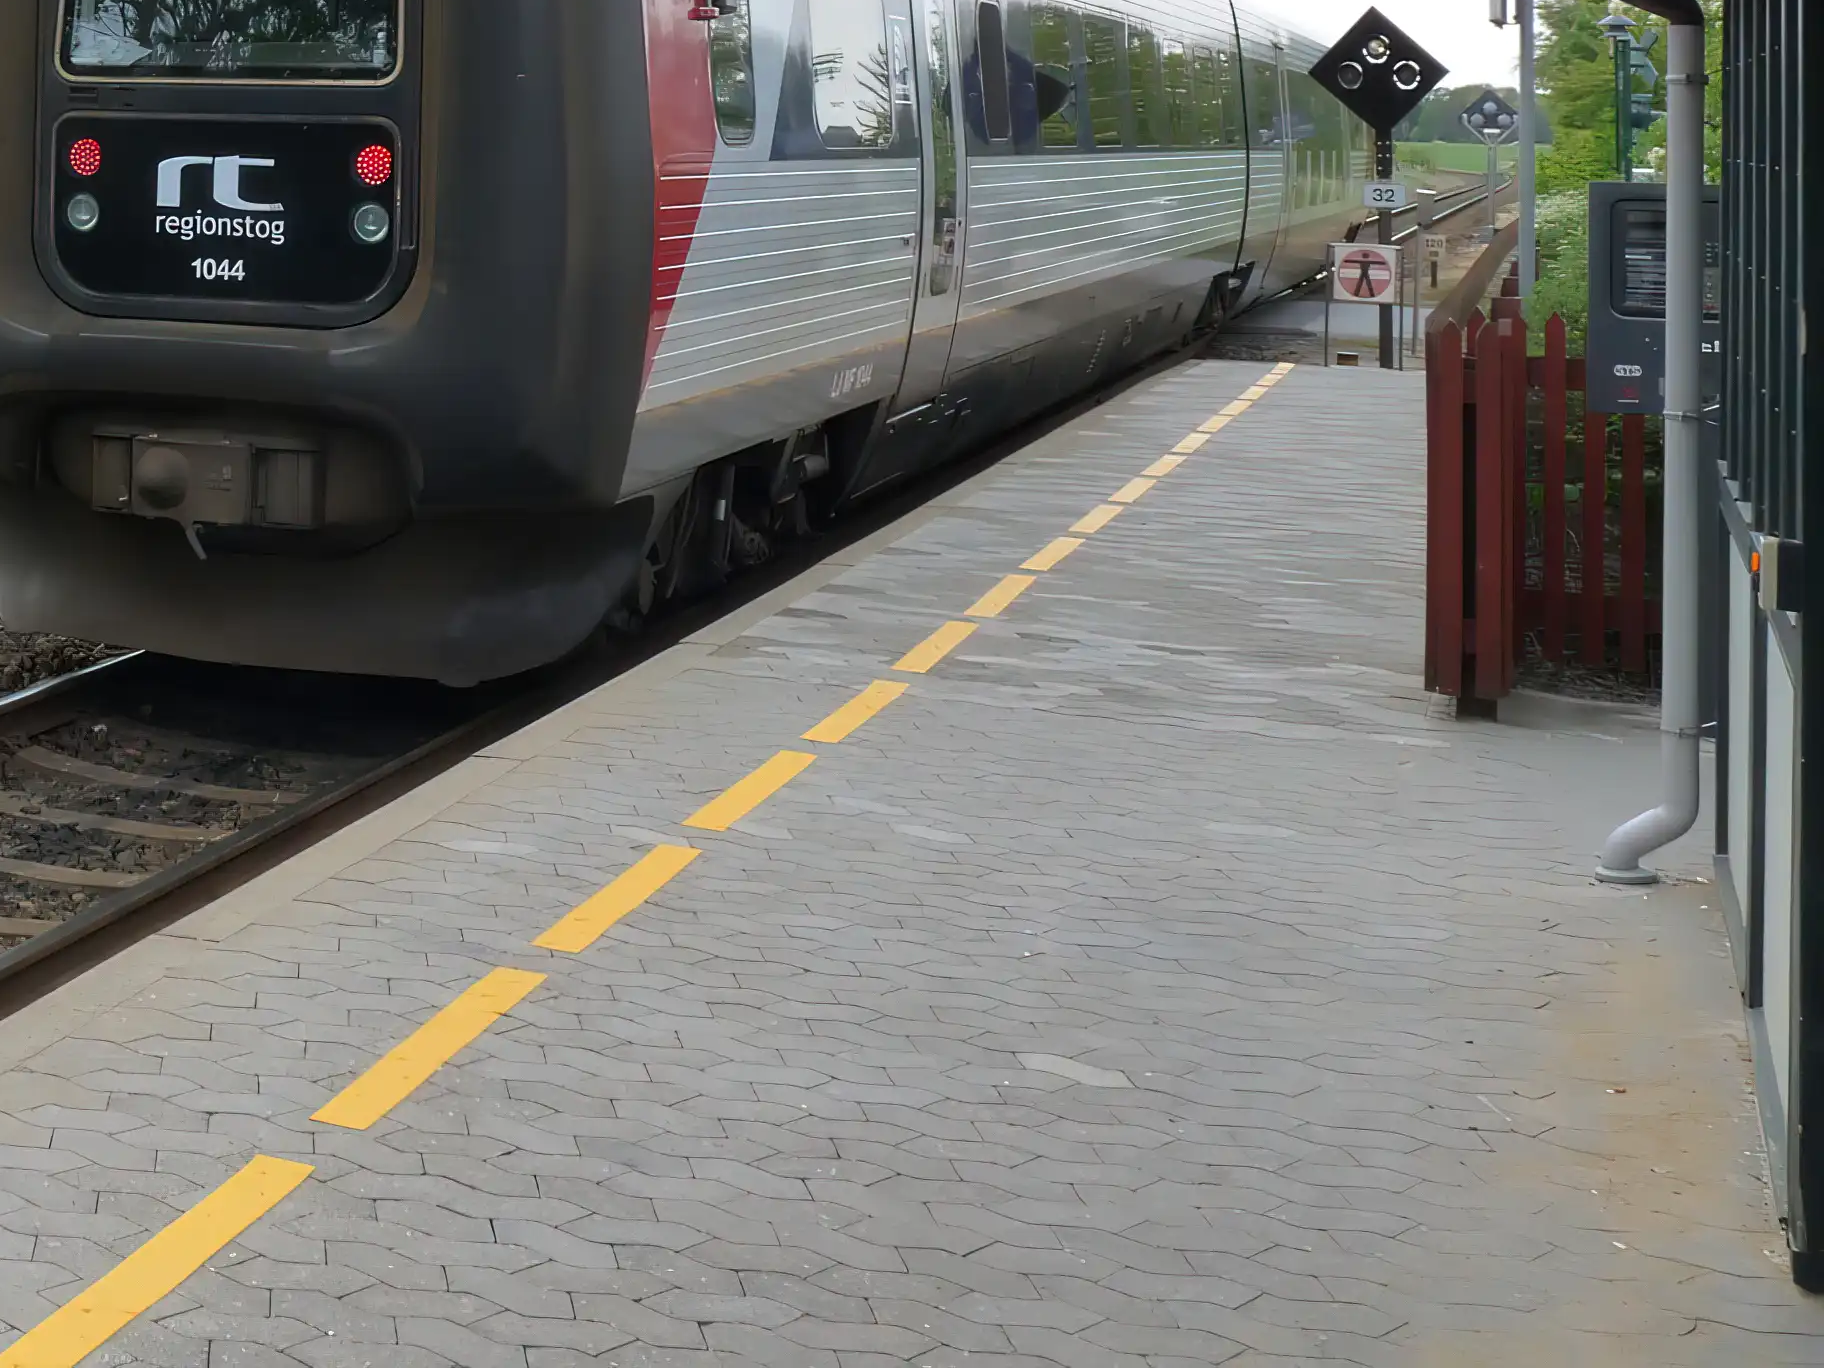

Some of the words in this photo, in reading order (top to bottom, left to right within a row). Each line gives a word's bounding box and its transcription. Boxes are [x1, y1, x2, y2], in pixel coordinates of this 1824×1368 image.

[1372, 188, 1396, 203] 32
[155, 209, 285, 245] regionstog
[191, 257, 246, 281] 1044
